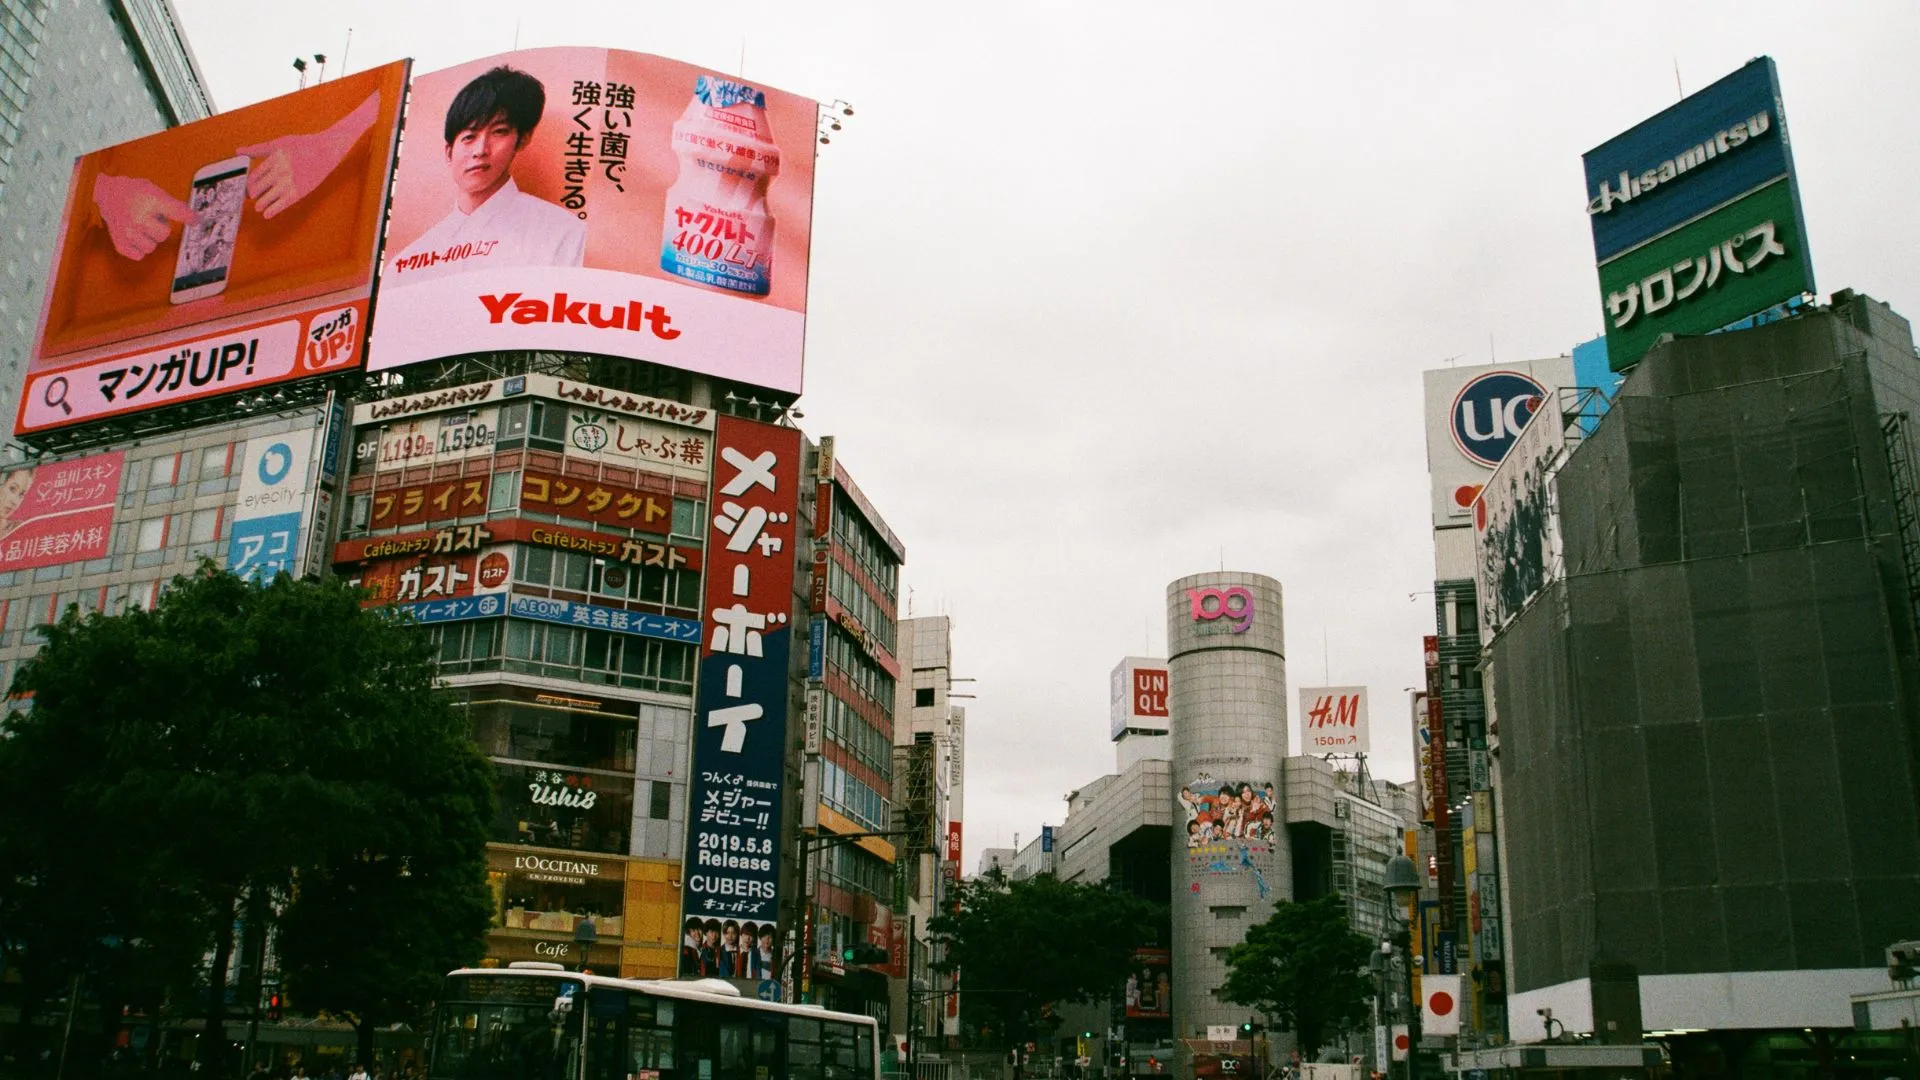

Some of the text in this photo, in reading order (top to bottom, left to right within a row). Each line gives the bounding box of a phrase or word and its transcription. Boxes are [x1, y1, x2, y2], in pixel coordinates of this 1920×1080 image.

[560, 80, 602, 219] 強く生きる。
[599, 82, 636, 192] 強い菌で、
[1586, 110, 1770, 215] Hisamitsu
[675, 206, 755, 244] ヤクルト
[1607, 219, 1785, 328] サロンパス
[311, 309, 352, 341] マンガ
[478, 292, 682, 341] Yakult
[308, 325, 357, 369] UP!
[98, 338, 259, 403] マンガUP!
[371, 382, 493, 419] しゃぶしゃぶバイキング
[558, 381, 708, 425] しゃぶしゃぶバイキング
[356, 442, 378, 459] 9F
[616, 424, 705, 465] しゃぶ葉
[54, 463, 117, 488] 品川スキン
[51, 483, 107, 507] クリニック
[245, 488, 297, 508] eyecity
[375, 481, 485, 521] プライス
[524, 476, 668, 522] コンタクト
[6, 526, 103, 561] 品川美容外科
[434, 524, 491, 553] ガスト
[619, 540, 687, 569] ガスト
[396, 564, 469, 600] ガスト
[482, 569, 506, 579] ガスト
[481, 599, 497, 613] 6F
[518, 601, 561, 616] AEON
[707, 446, 789, 754] メジャーボーイ
[1185, 587, 1254, 634] 109
[573, 606, 698, 637] 英会話イーオン
[1139, 674, 1164, 692] UN
[1308, 694, 1360, 729] H&M
[1315, 736, 1346, 746] 150m
[529, 783, 597, 809] Ushi8
[704, 788, 771, 808] メジャー
[699, 832, 772, 854] 2019.5.8
[515, 856, 599, 876] L'OCCITANE
[699, 849, 771, 871] Release
[690, 874, 775, 899] CUBERS
[704, 899, 765, 913] キューバーズ
[535, 941, 568, 958] Café
